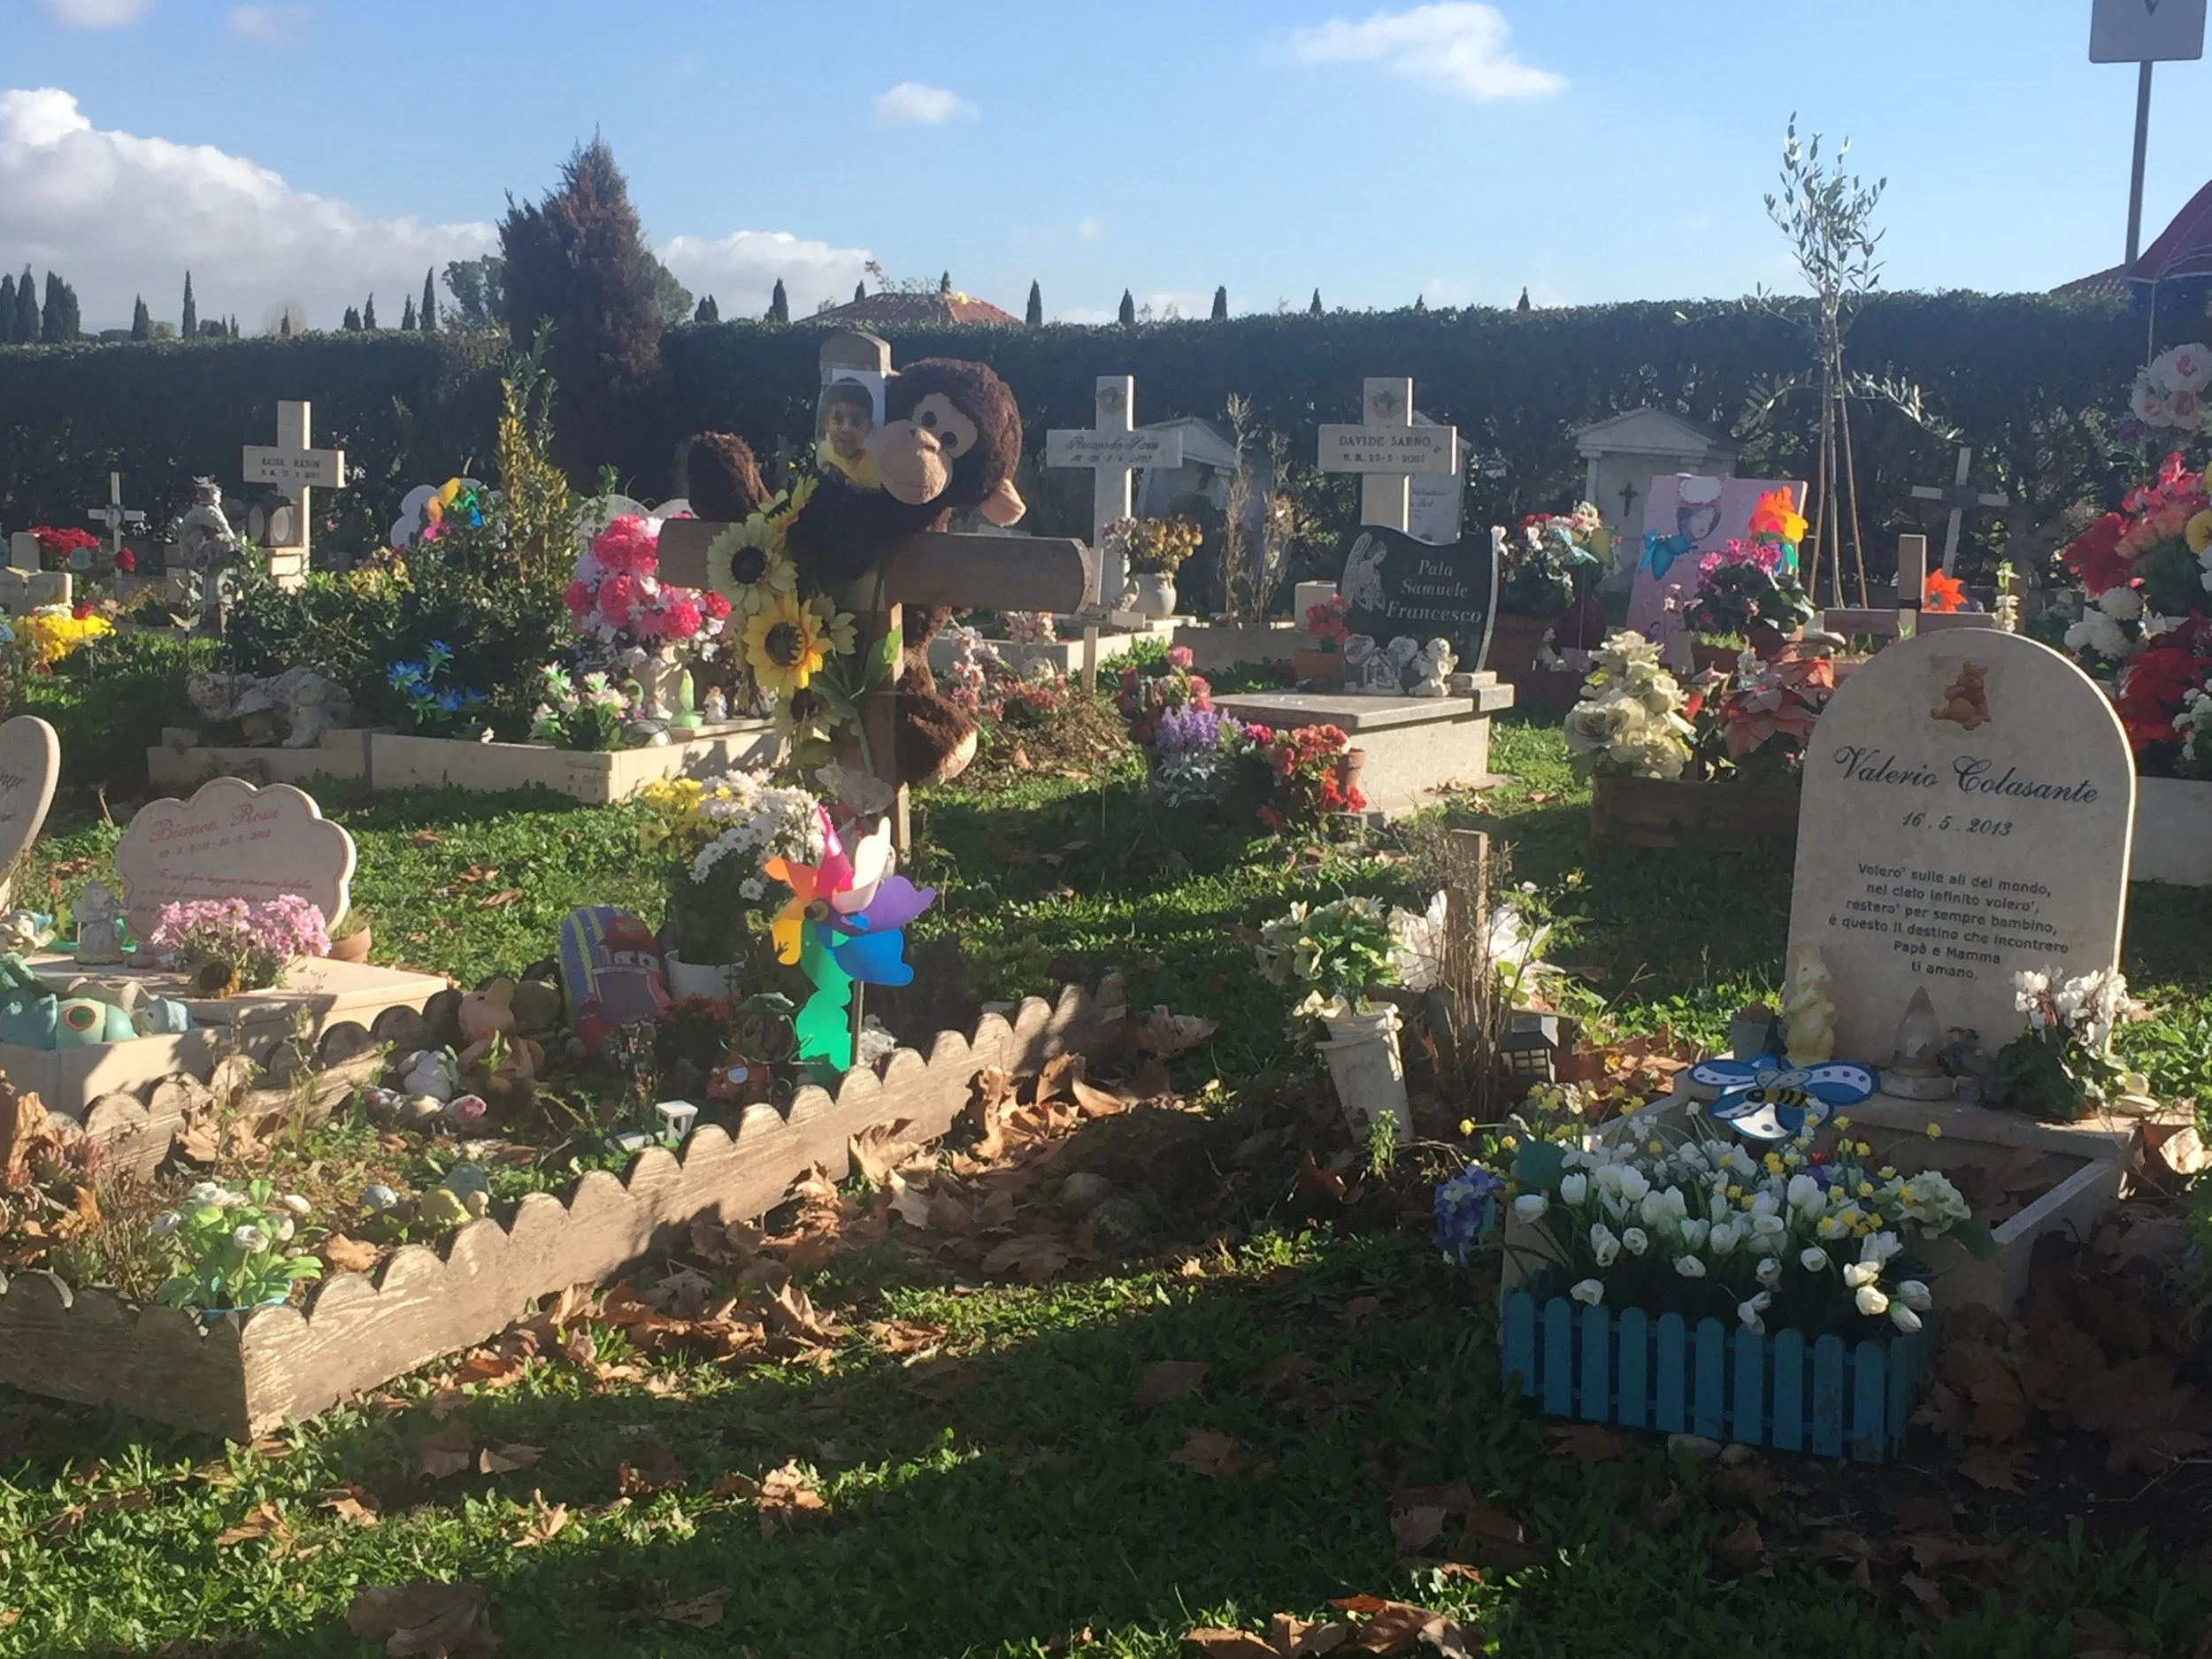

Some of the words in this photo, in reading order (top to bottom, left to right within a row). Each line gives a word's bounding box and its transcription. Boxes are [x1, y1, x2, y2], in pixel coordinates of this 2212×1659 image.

[1339, 435, 1384, 446] DAVIDE
[1390, 435, 1432, 447] SARNO
[1417, 559, 1454, 577] Pala
[1401, 578, 1469, 598] Samuele
[1386, 601, 1482, 623] Francesco
[1833, 745, 1939, 787] Valerio
[1953, 755, 2098, 803] Colasante
[1858, 863, 1906, 879] Volero'
[1910, 870, 1944, 884] sulle
[1948, 873, 1966, 886] ali
[1970, 875, 1993, 888] del
[1998, 880, 2051, 897] mondo,
[1866, 884, 1887, 895] nel
[1892, 886, 1925, 899] cielo
[1930, 889, 1980, 905] infinito
[1828, 912, 1838, 926] è
[1841, 917, 1888, 933] questo
[1893, 921, 1902, 933] il
[1907, 923, 1958, 940] destino
[1964, 931, 1989, 944] che
[1846, 900, 1900, 914] restero'
[1905, 906, 1929, 918] per
[1932, 910, 1986, 926] sempre
[1991, 914, 2058, 937] bambino,
[1893, 940, 1927, 956] Papà
[1932, 946, 1941, 956] e
[1946, 946, 2001, 964] Mamma
[1911, 960, 1922, 972] ti
[1925, 964, 1978, 979] amano.
